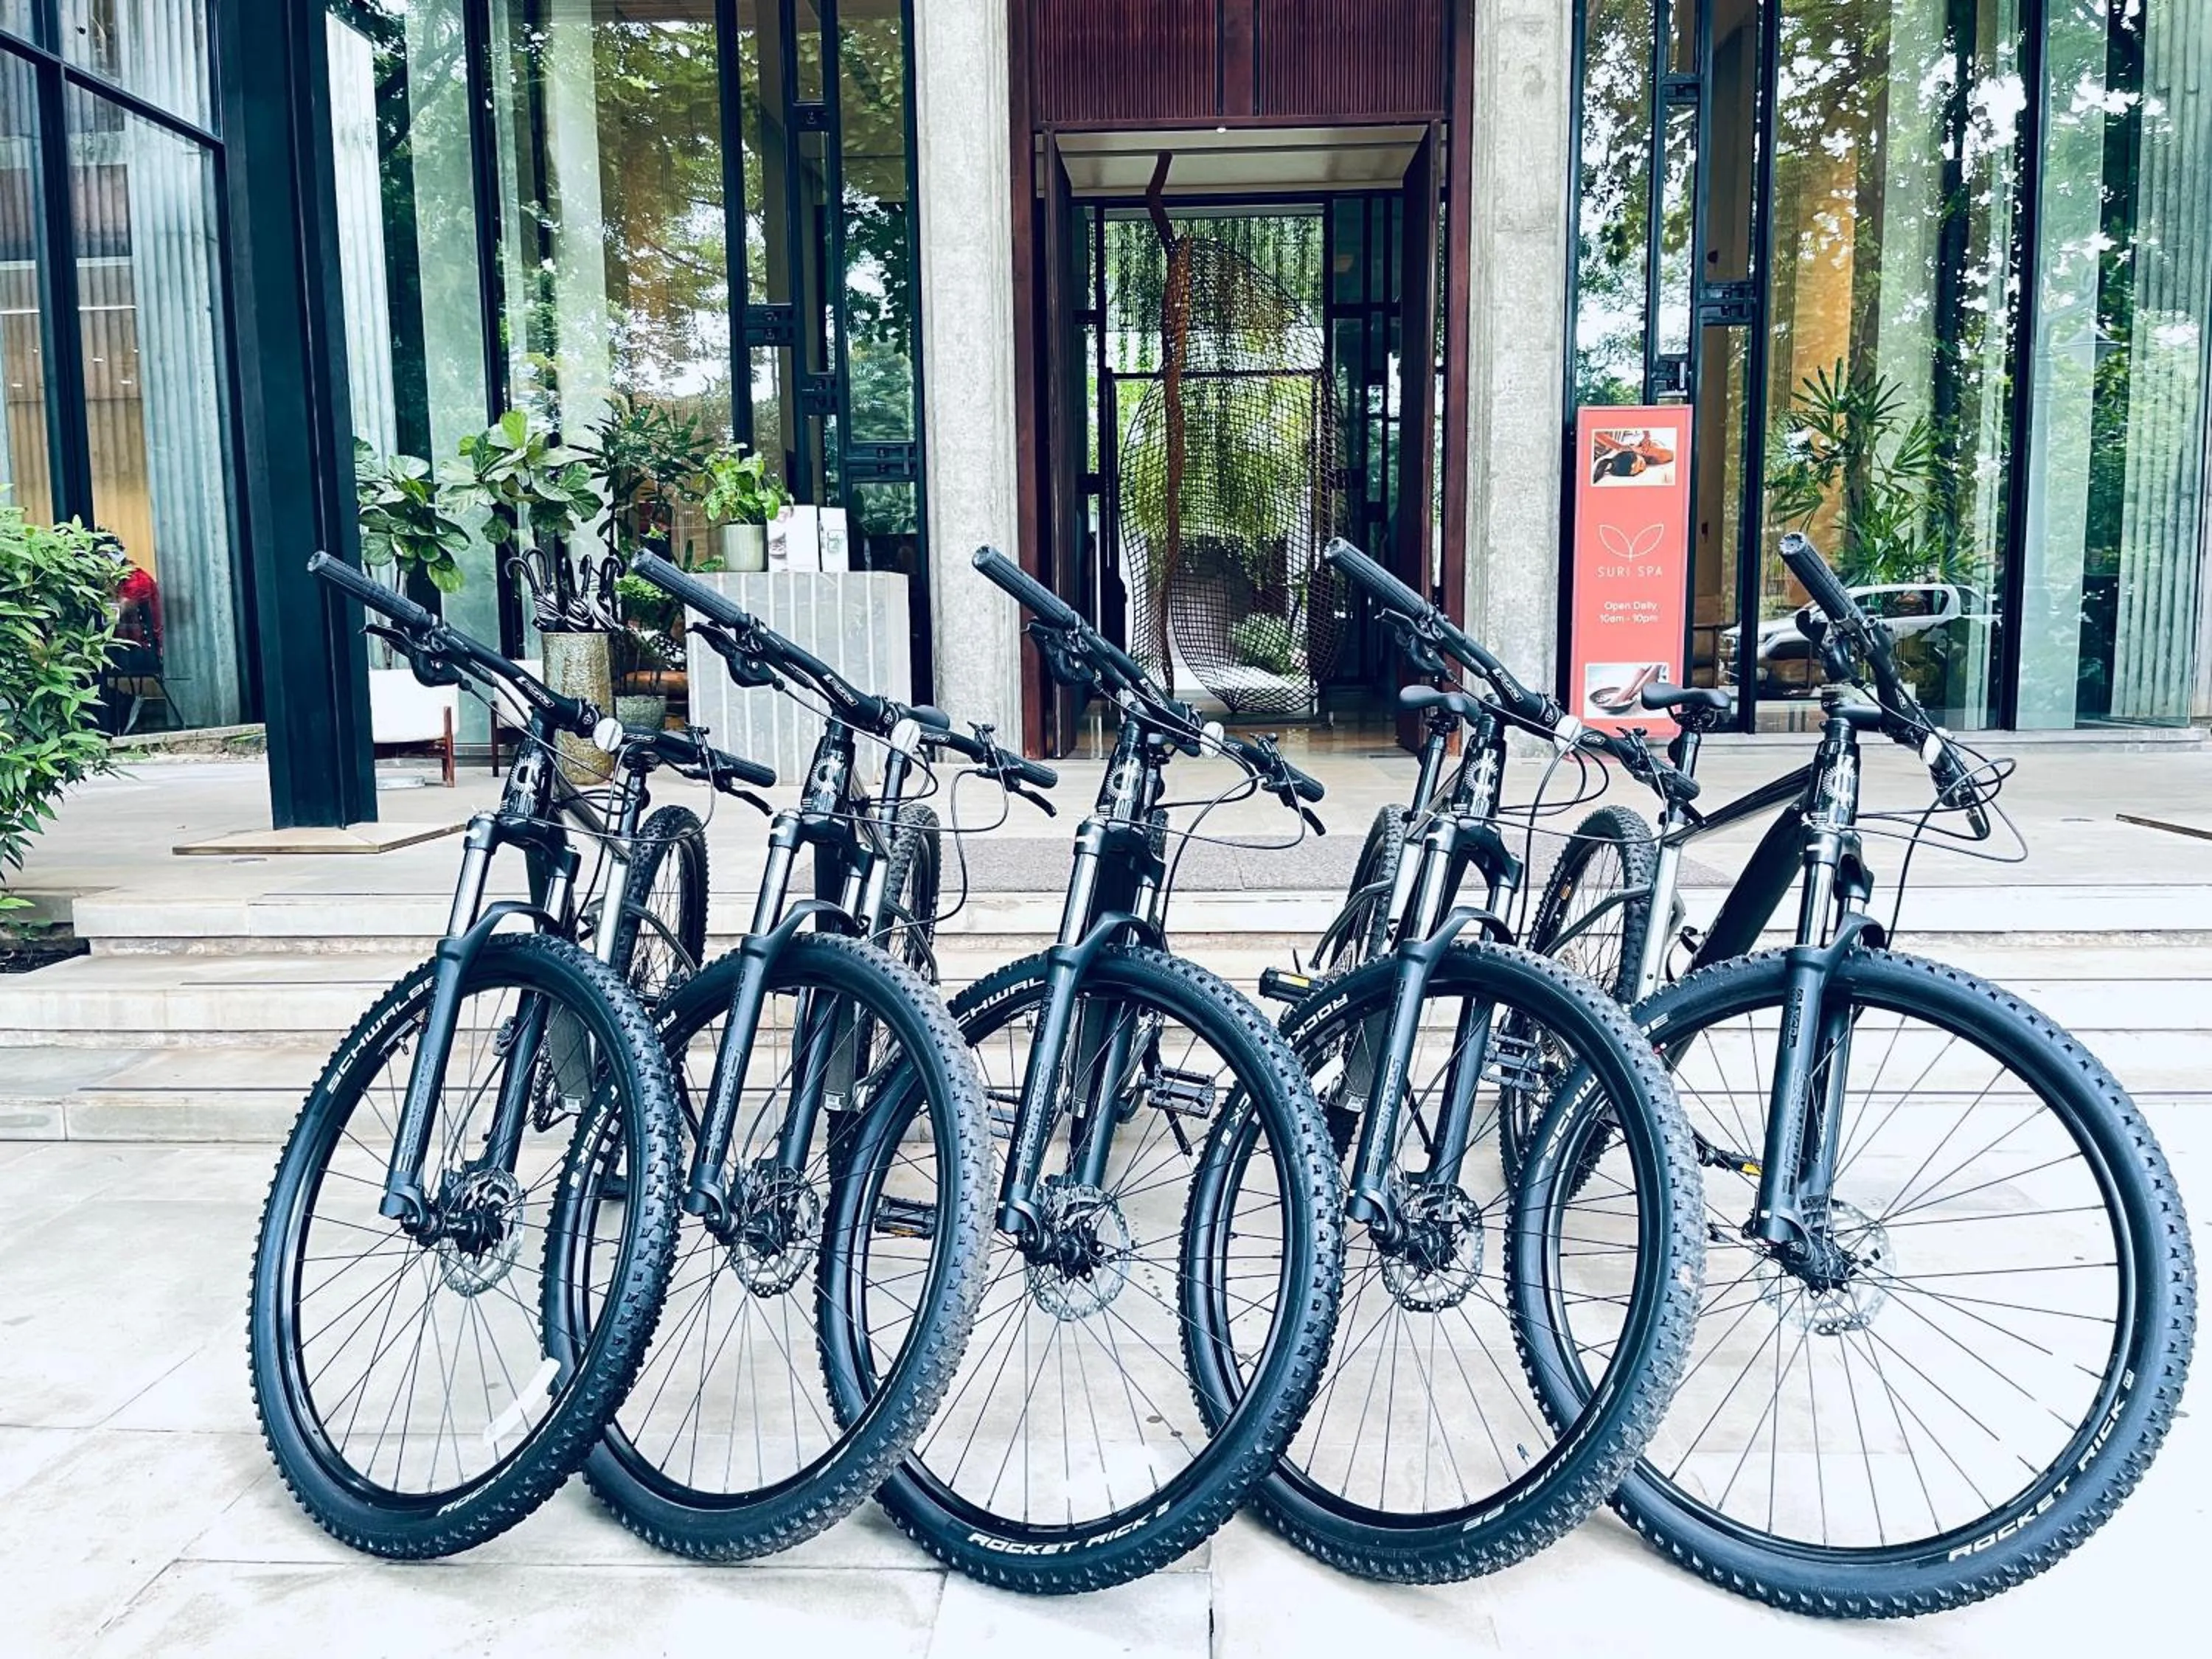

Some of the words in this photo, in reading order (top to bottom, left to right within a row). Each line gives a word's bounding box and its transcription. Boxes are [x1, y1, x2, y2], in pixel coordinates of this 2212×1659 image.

[1596, 566, 1631, 577] SURI
[1638, 566, 1663, 577] SPA
[1599, 613, 1625, 623] 10am
[1604, 601, 1632, 612] Open
[1633, 601, 1659, 612] Daily
[956, 977, 1046, 1029] CHWAL
[1284, 993, 1349, 1048] ROCK
[327, 975, 434, 1094] SCHWALBE
[1948, 1475, 2070, 1562] ROCKET
[2078, 1395, 2126, 1472] RICK
[967, 1532, 1079, 1555] ROCKET
[1085, 1512, 1151, 1548] RICK
